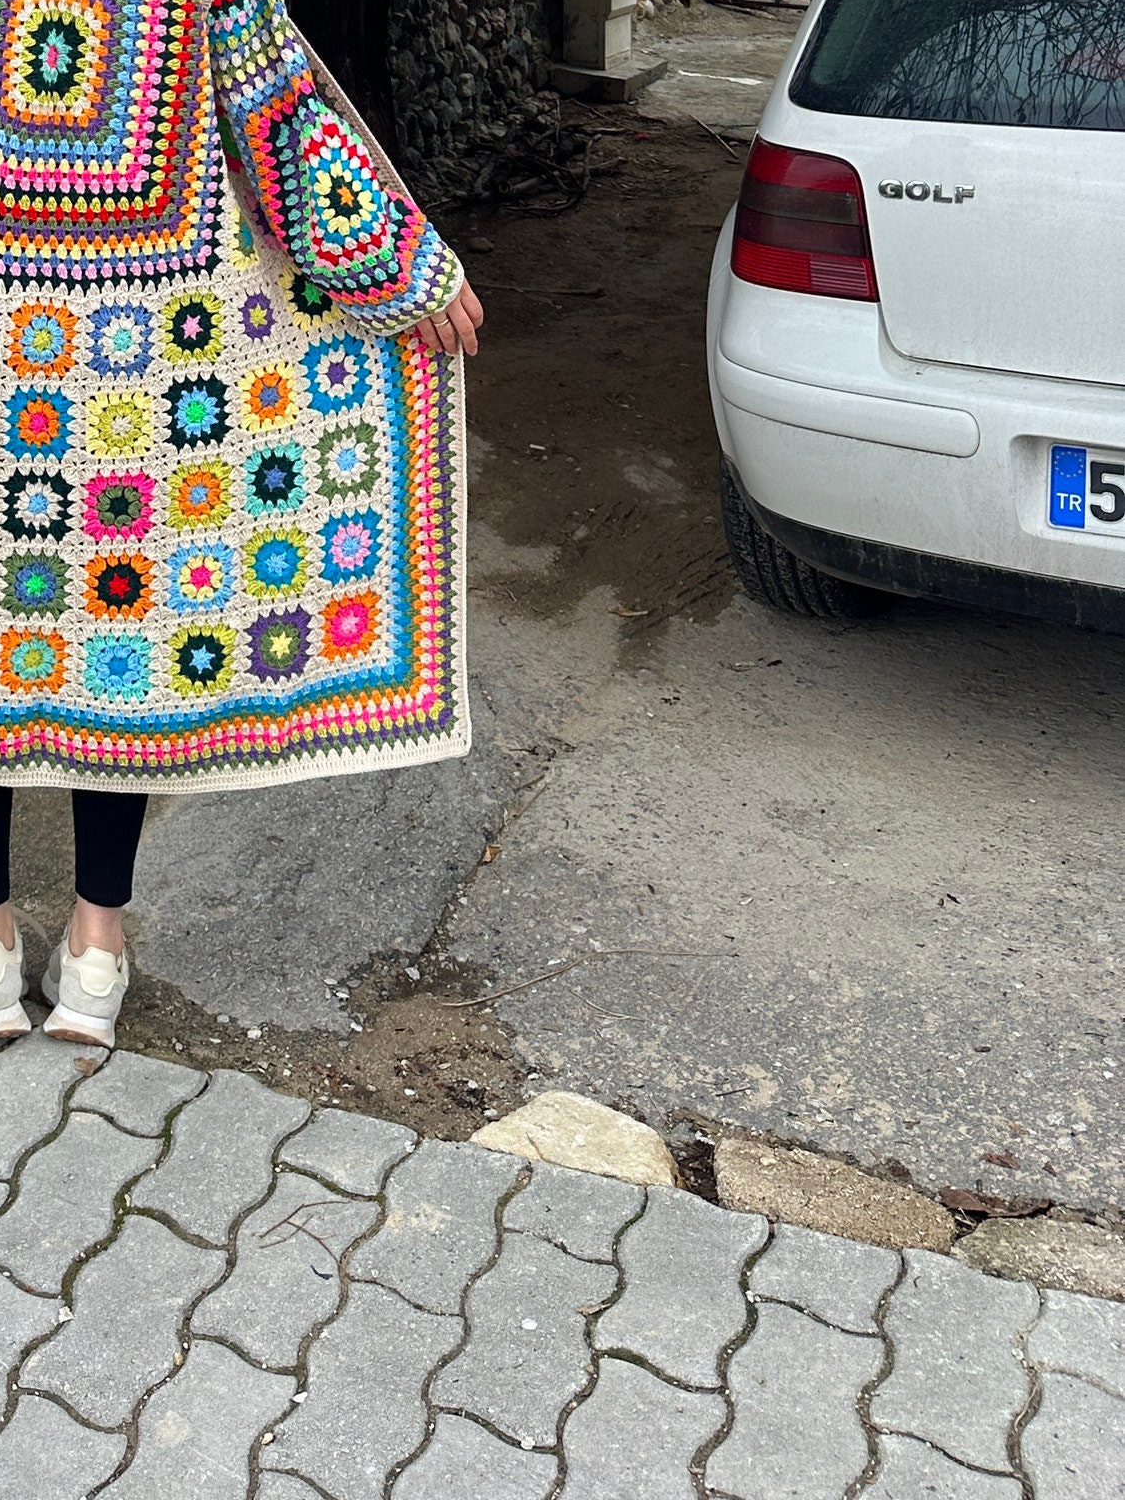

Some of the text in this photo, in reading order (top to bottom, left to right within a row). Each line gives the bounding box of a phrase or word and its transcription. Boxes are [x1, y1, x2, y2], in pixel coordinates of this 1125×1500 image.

[878, 179, 973, 204] GOLF
[1056, 461, 1125, 522] TR 5
